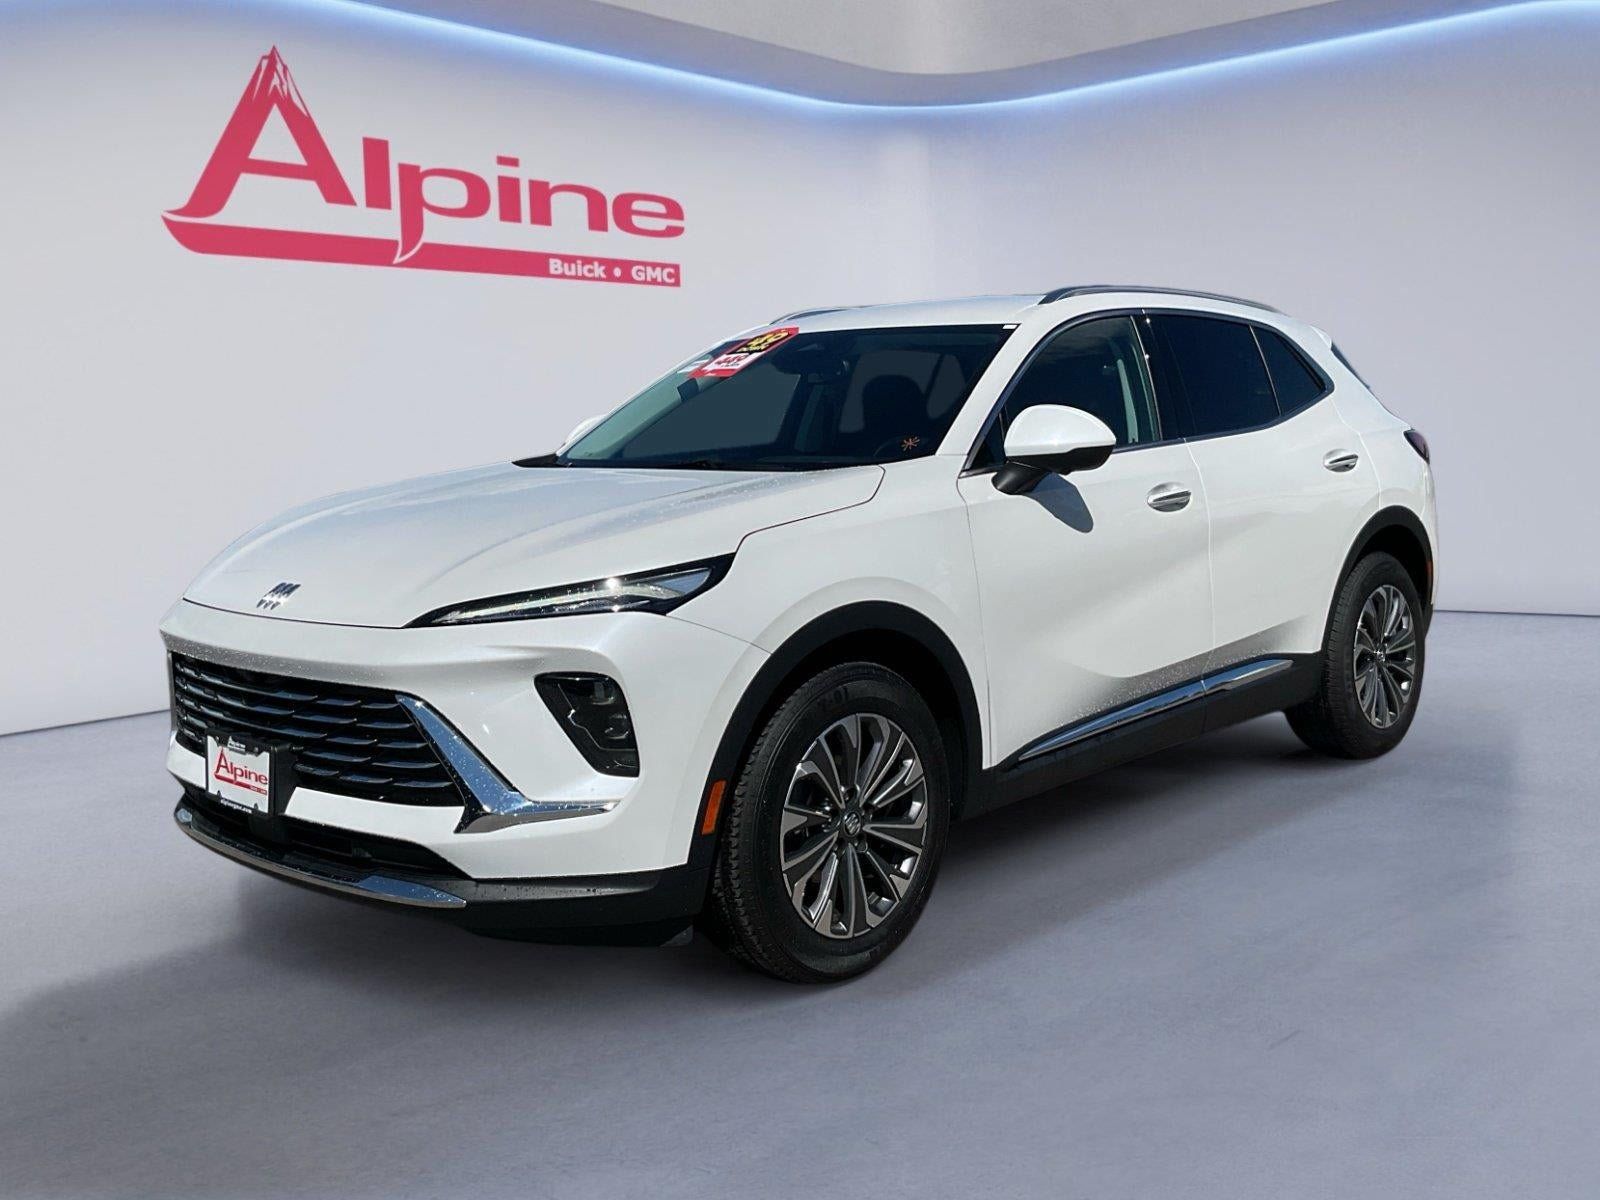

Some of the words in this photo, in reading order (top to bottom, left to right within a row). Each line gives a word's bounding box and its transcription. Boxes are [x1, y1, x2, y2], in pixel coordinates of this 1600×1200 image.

[161, 45, 685, 264] Alpine
[549, 257, 607, 279] Buick
[631, 265, 676, 284] GMC
[215, 747, 269, 785] Alpine
